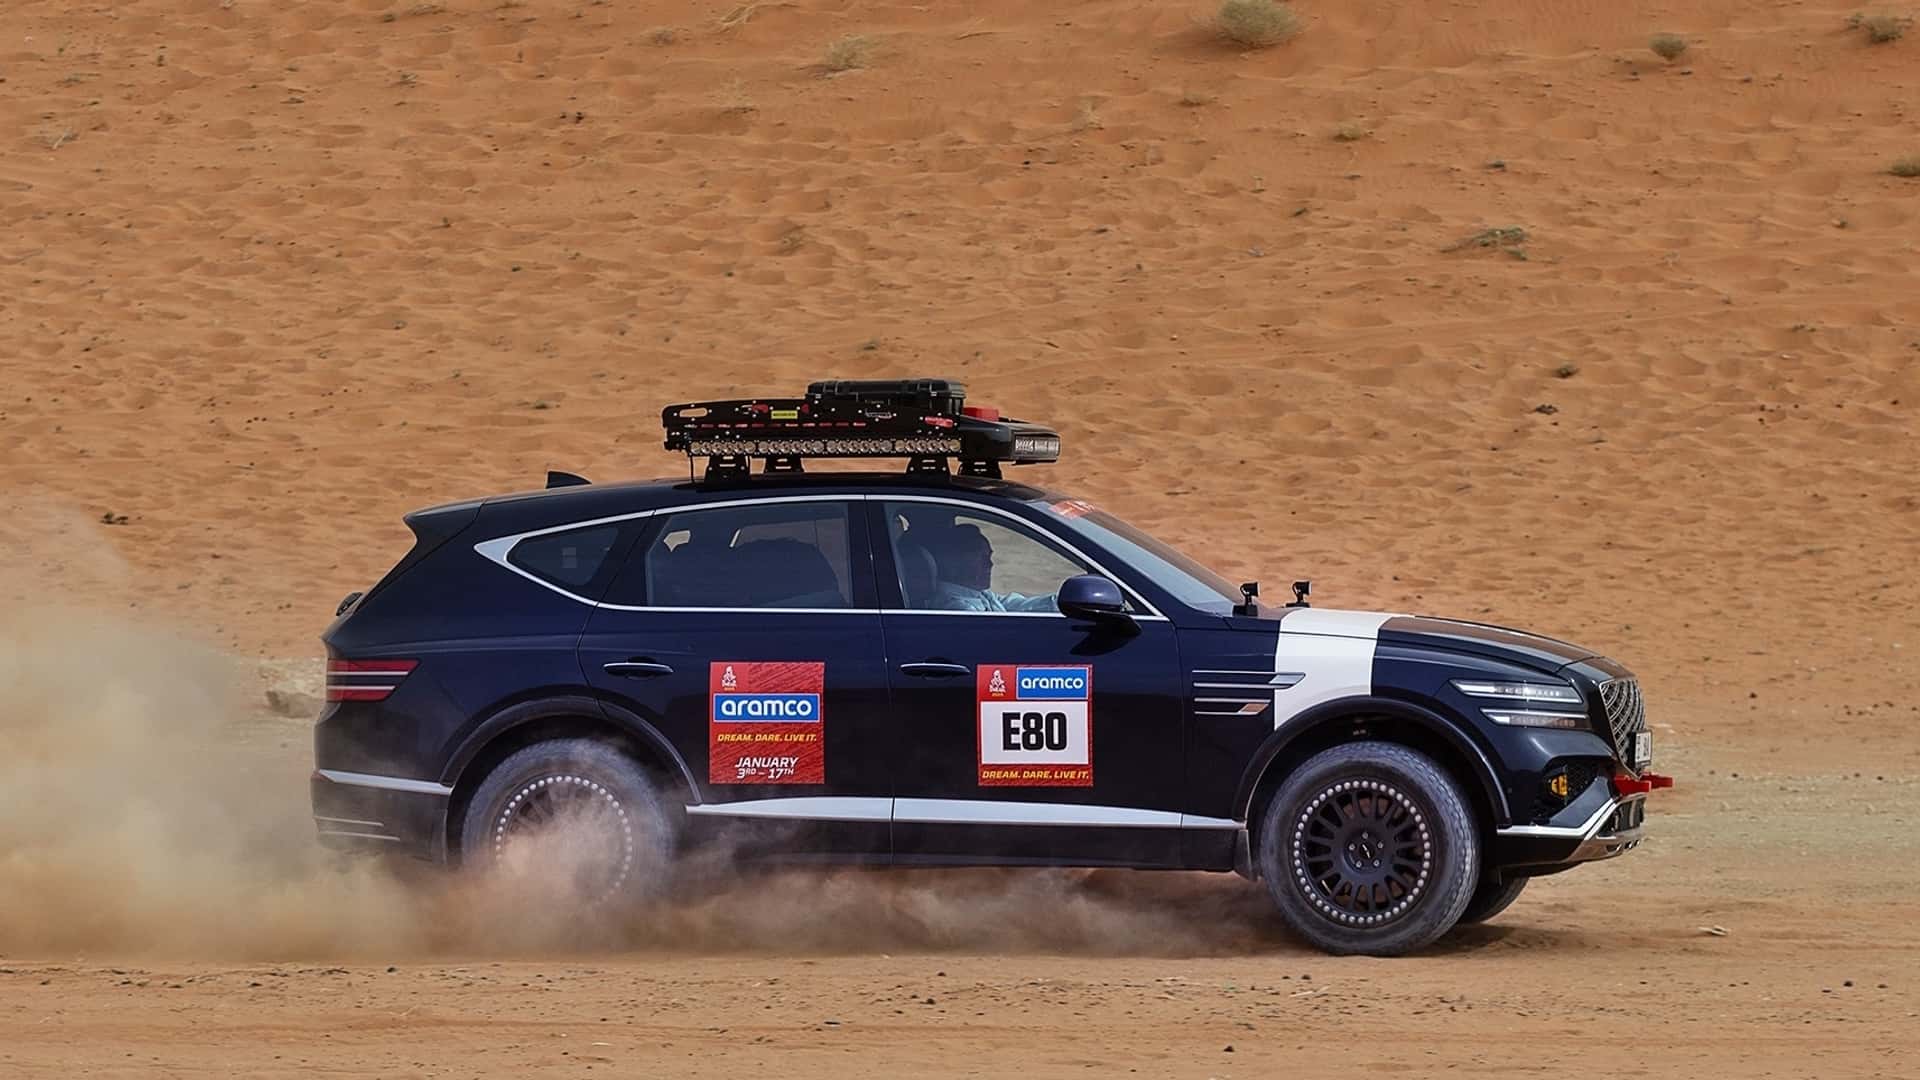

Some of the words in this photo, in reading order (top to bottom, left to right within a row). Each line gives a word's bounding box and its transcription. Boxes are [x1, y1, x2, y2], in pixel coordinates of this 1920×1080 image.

[1021, 677, 1083, 689] aramco
[721, 700, 812, 716] aramco
[1003, 712, 1067, 751] E80
[717, 734, 753, 742] DREAM.
[755, 734, 783, 742] DARE.
[784, 734, 805, 742] LIVE
[805, 734, 817, 742] IT.
[735, 757, 799, 768] JANUARY
[982, 771, 1021, 779] DREAM.
[1022, 771, 1052, 779] DARE.
[1054, 771, 1076, 779] LIVE
[1077, 771, 1089, 779] IT.
